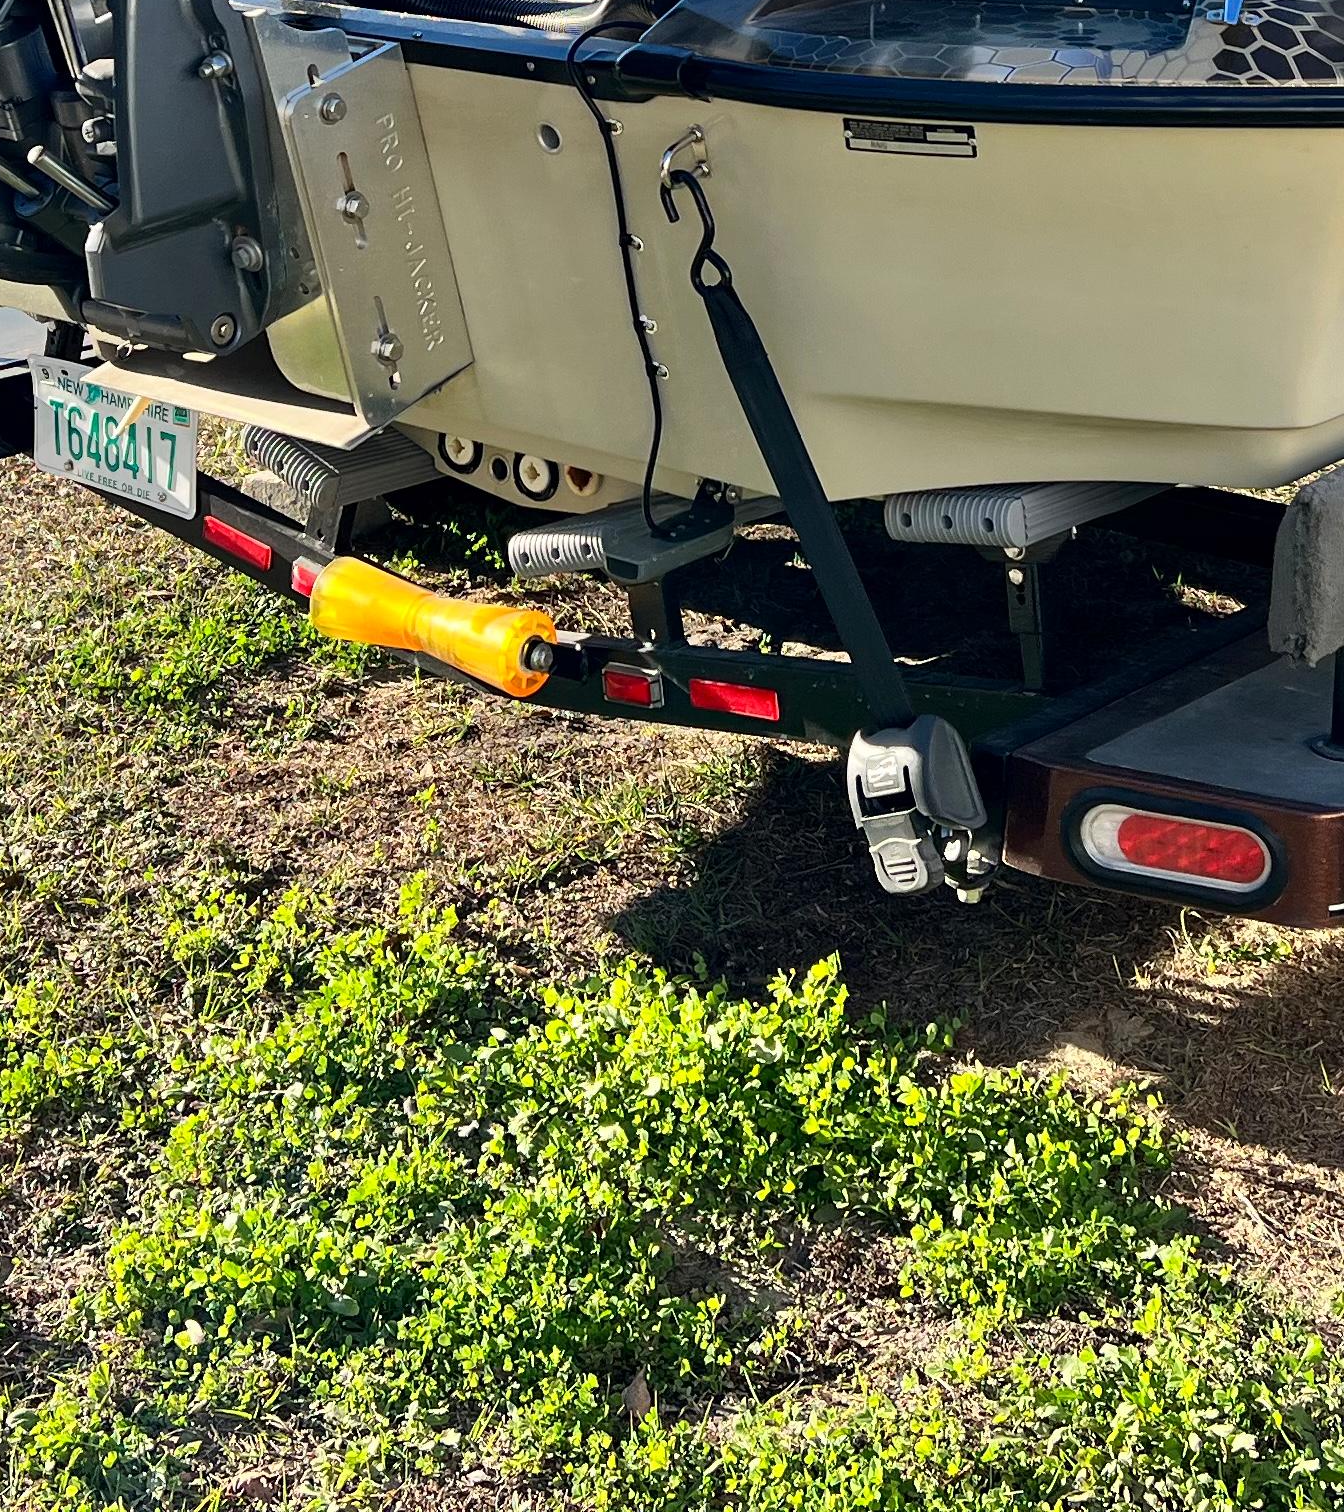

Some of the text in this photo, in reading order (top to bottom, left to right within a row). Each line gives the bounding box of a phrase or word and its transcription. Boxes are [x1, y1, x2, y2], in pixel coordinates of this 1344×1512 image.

[376, 112, 444, 351] PRO HI-JACKER
[41, 368, 50, 380] 9
[57, 376, 84, 397] NEW
[100, 389, 169, 423] HAMPHIRE
[49, 399, 177, 491] T648417
[77, 469, 151, 500] LIVE FREE OR DIE
